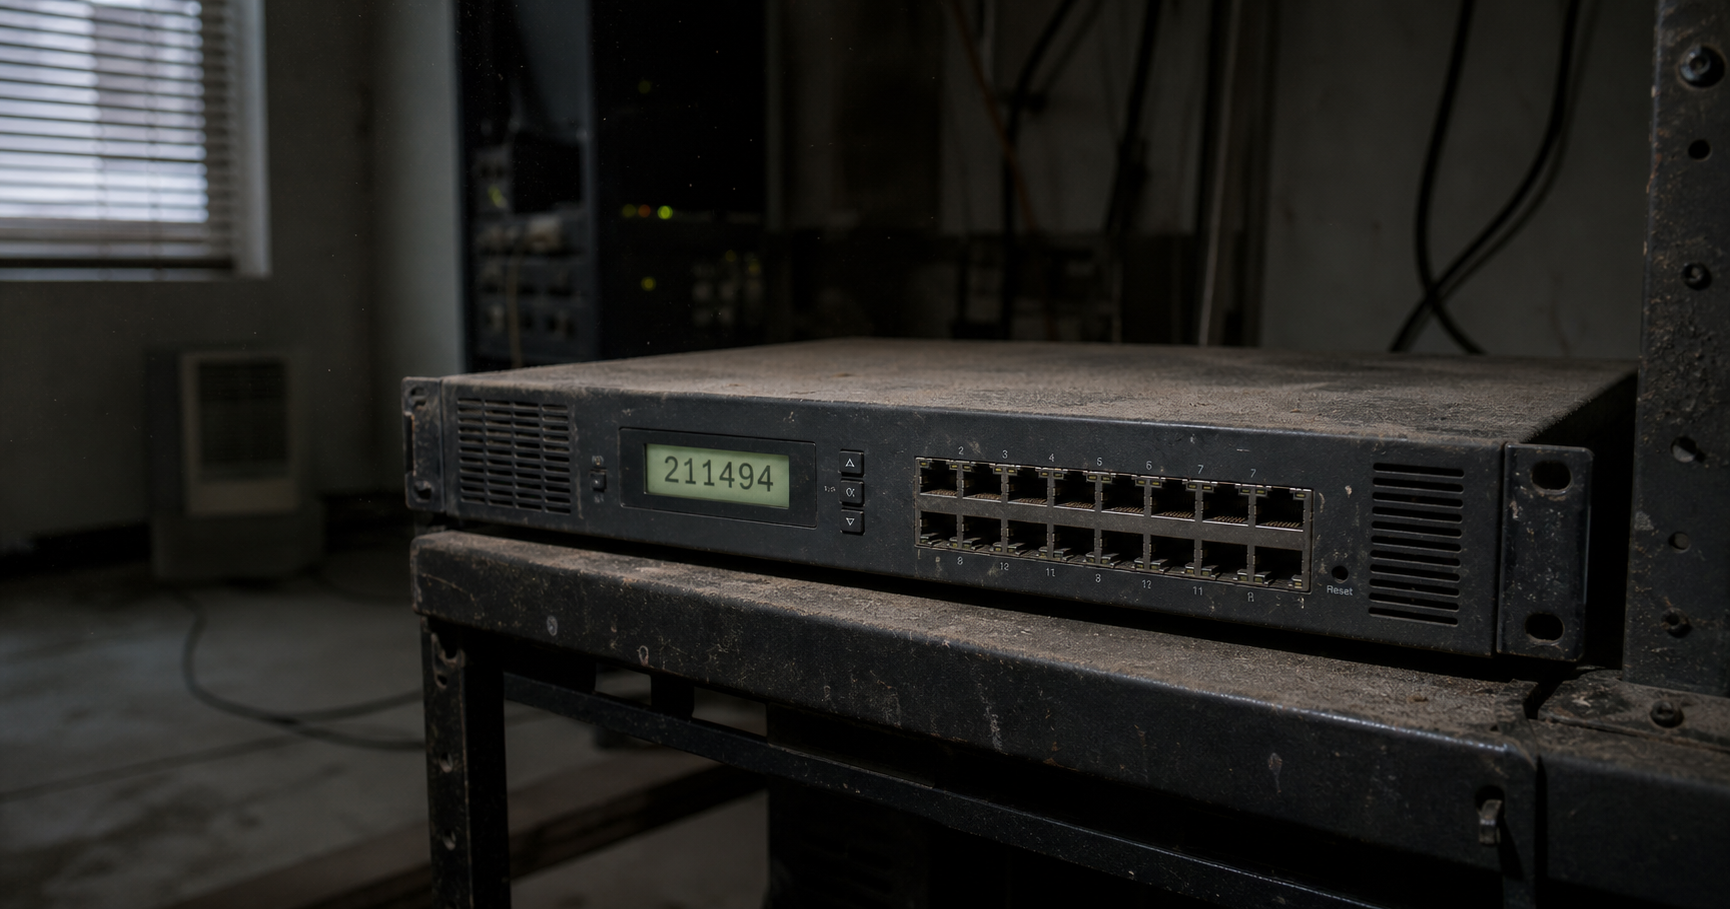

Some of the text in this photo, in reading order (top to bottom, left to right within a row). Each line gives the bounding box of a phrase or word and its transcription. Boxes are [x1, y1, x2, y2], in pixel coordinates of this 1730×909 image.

[664, 455, 774, 492] 211494
[958, 445, 964, 455] 2
[1002, 449, 1008, 459] 3
[1048, 453, 1055, 462] 4
[1146, 460, 1153, 470] 6
[1197, 464, 1204, 474] 7
[1250, 468, 1257, 478] 7
[957, 556, 963, 566] 8
[1141, 579, 1152, 589] 12
[1192, 585, 1203, 596] 11
[1326, 584, 1354, 597] Reset
